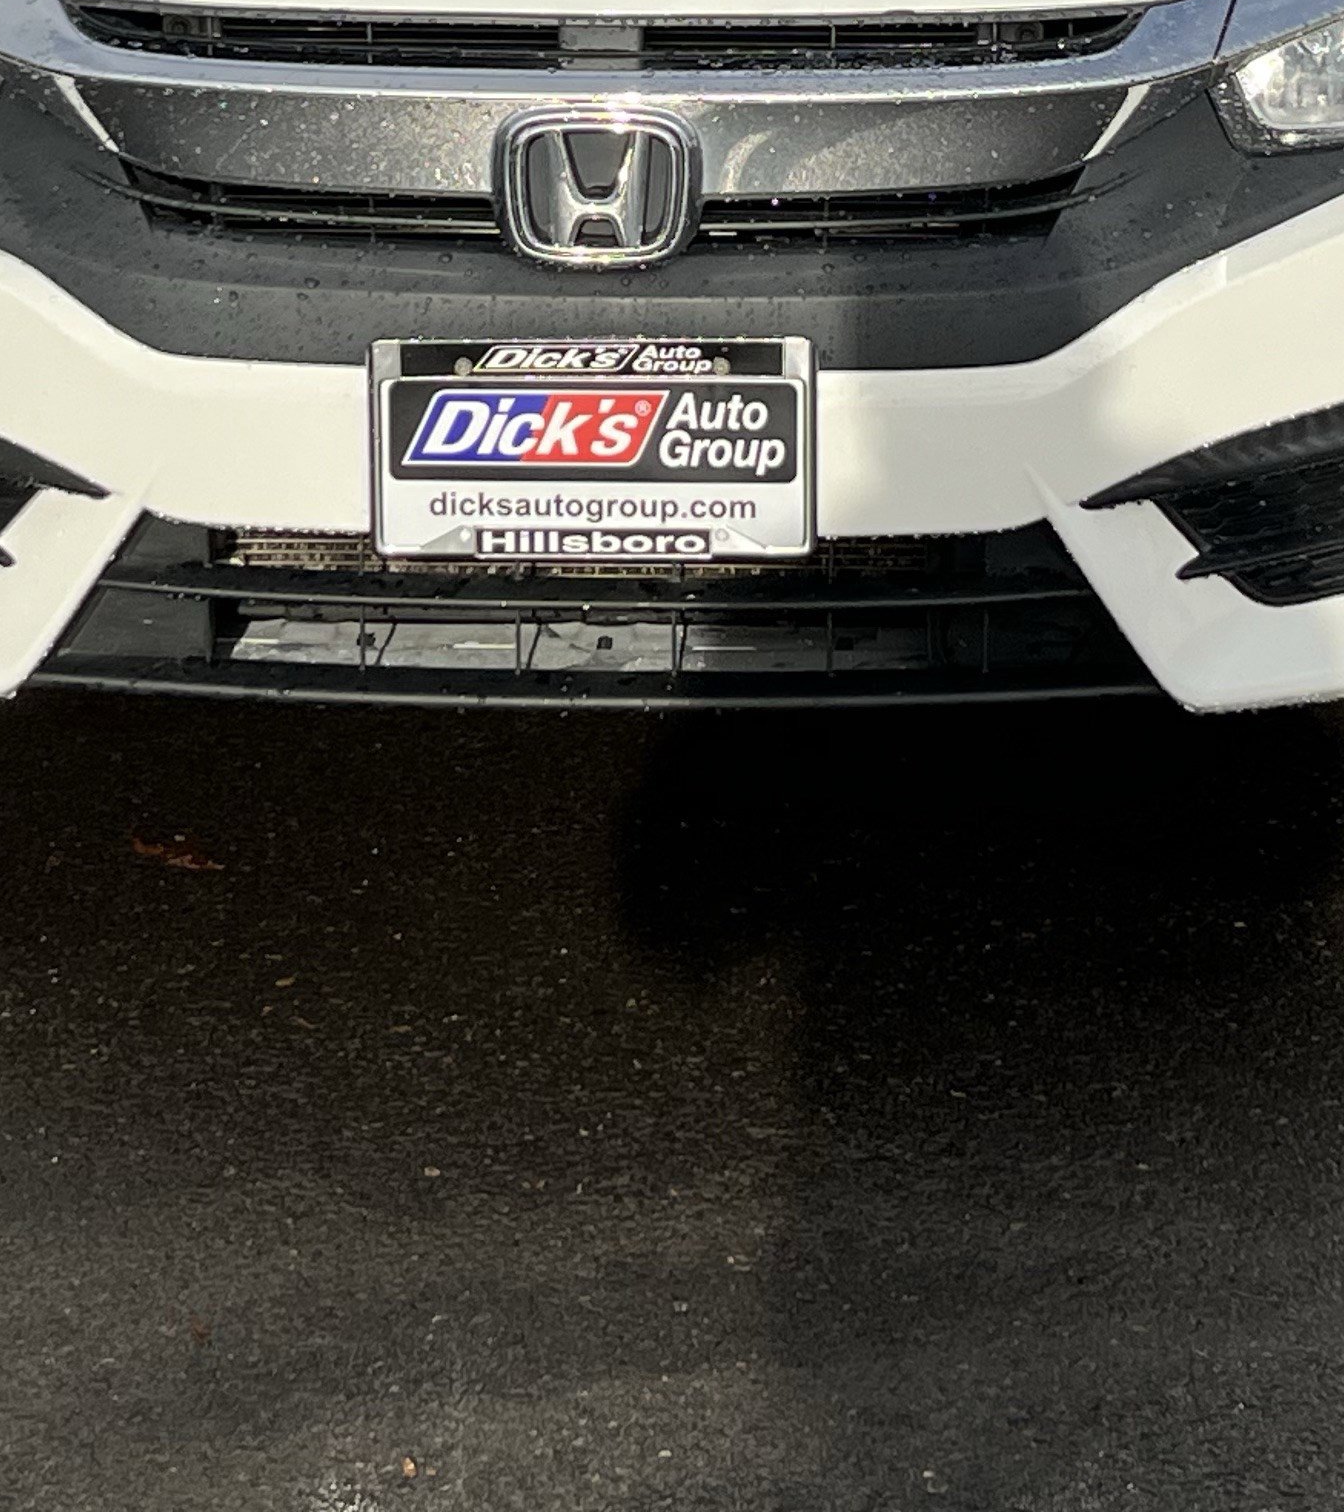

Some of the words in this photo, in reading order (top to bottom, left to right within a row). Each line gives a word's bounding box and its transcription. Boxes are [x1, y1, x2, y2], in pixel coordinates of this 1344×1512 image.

[484, 346, 623, 370] Dick's
[636, 345, 702, 359] Auto
[632, 358, 713, 374] Group
[421, 397, 639, 456] Dick's
[666, 393, 769, 431] Auto
[658, 431, 786, 476] Group
[429, 492, 757, 523] dicksautogroup.com
[481, 531, 706, 554] Hillsboro
